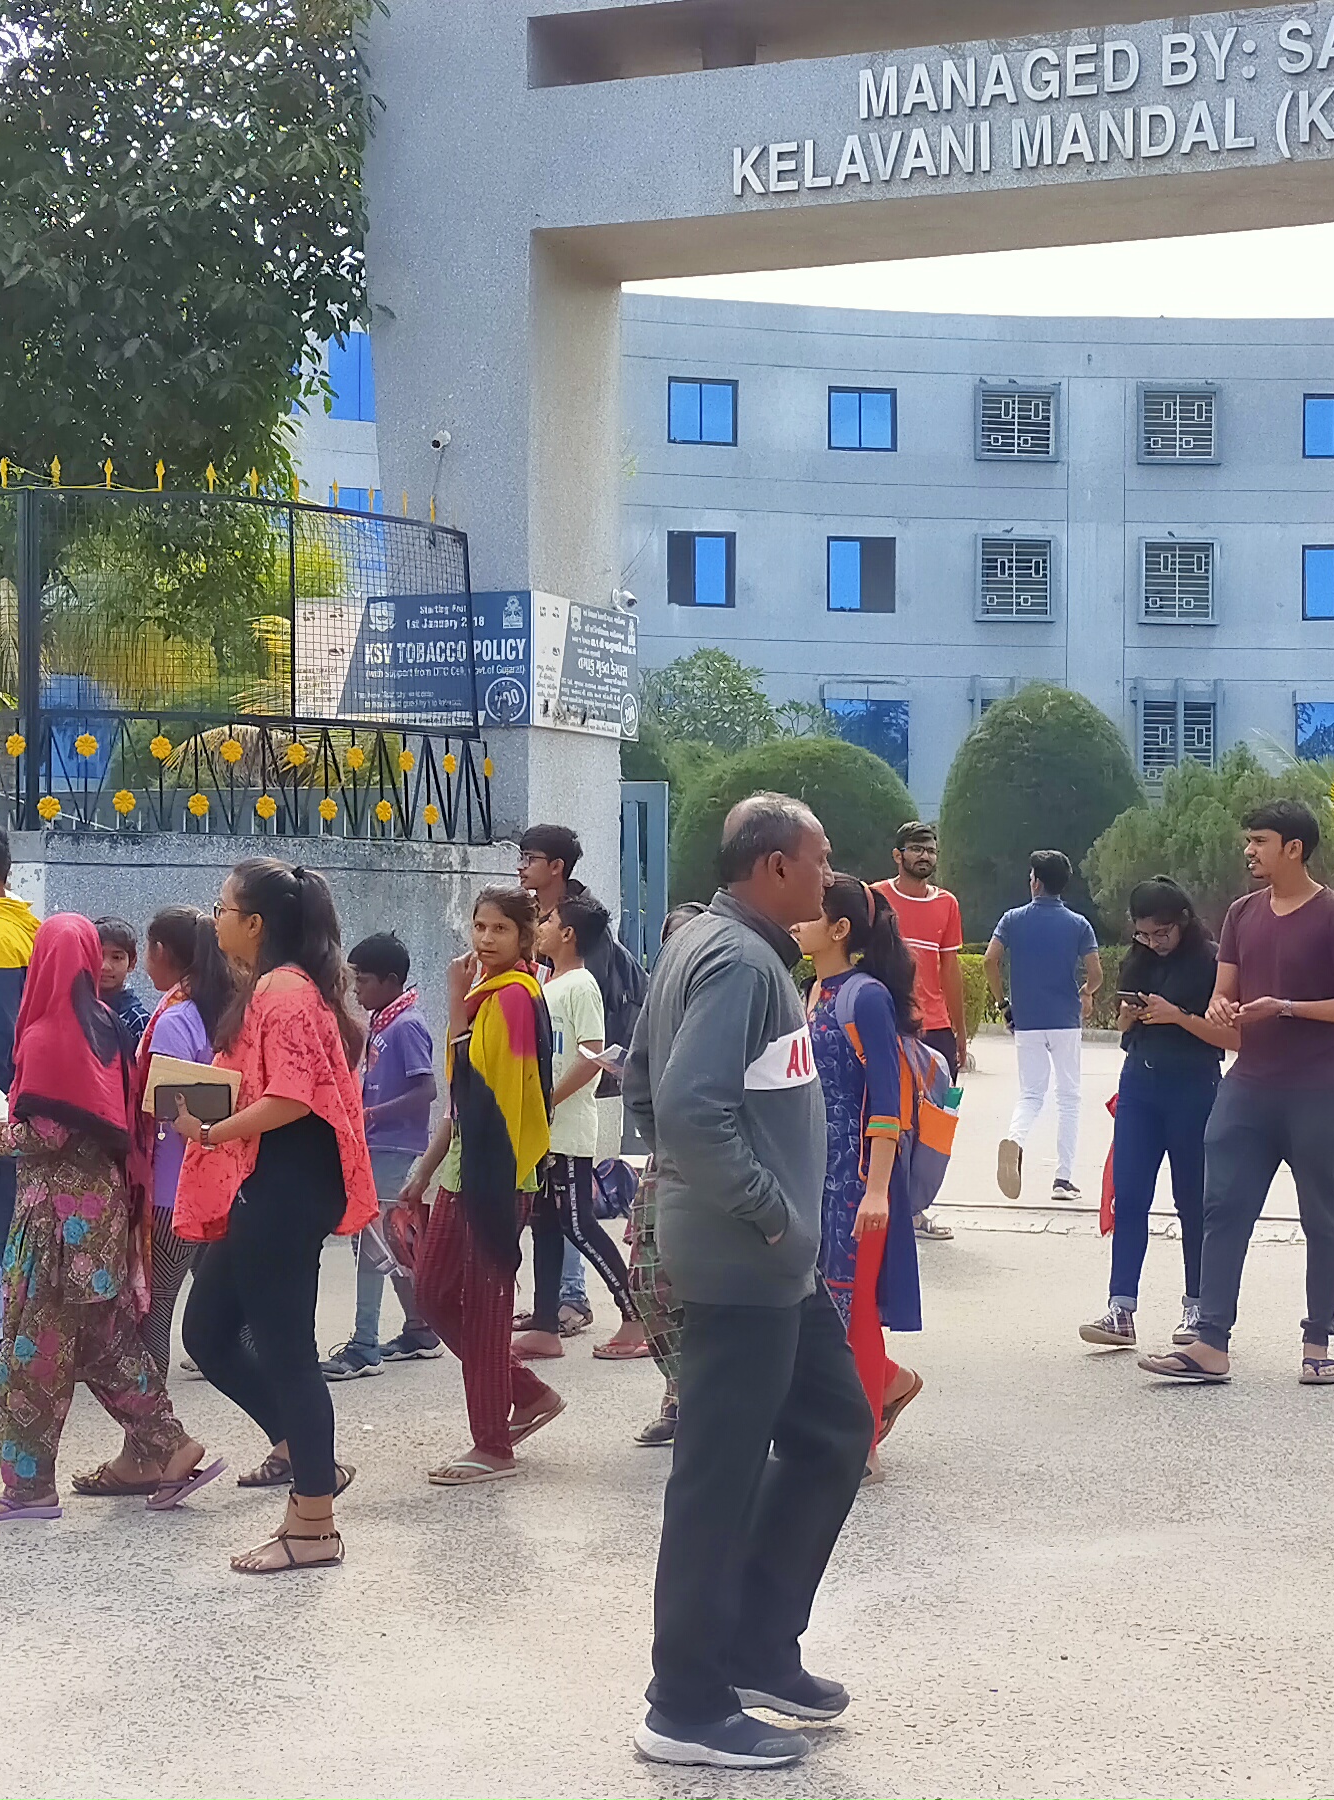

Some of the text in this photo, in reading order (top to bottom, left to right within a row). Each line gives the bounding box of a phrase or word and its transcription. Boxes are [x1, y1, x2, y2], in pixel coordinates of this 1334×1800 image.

[858, 39, 1140, 120] MANAGED
[1161, 25, 1258, 88] BY:
[731, 119, 992, 197] KELAVANI
[1010, 96, 1256, 171] MANDAL
[396, 640, 467, 664] TOBACCO
[473, 638, 527, 662] POLICY
[460, 616, 485, 627] 218
